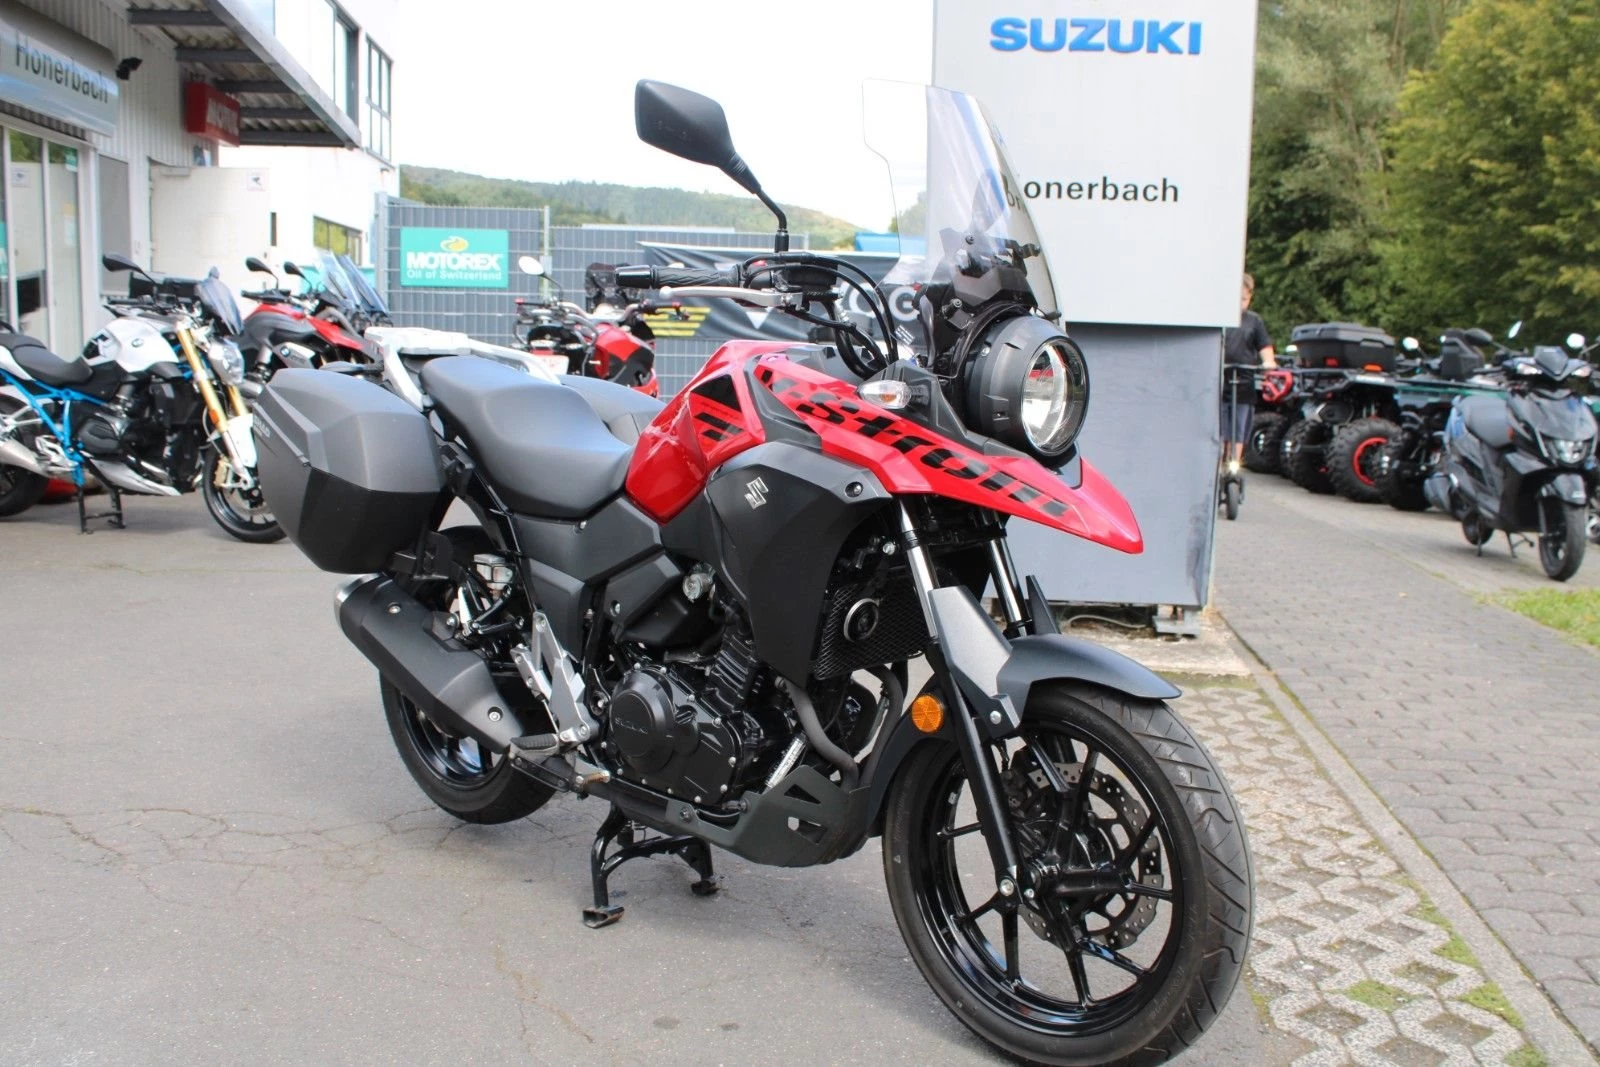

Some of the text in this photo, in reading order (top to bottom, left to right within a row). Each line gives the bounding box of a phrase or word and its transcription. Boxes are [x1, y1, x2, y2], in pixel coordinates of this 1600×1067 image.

[990, 17, 1203, 55] SUZUKI
[16, 35, 108, 104] Honerbach
[1022, 176, 1178, 203] onerbach
[406, 252, 503, 271] MOTOREX
[406, 270, 502, 281] Oil of Switzerland
